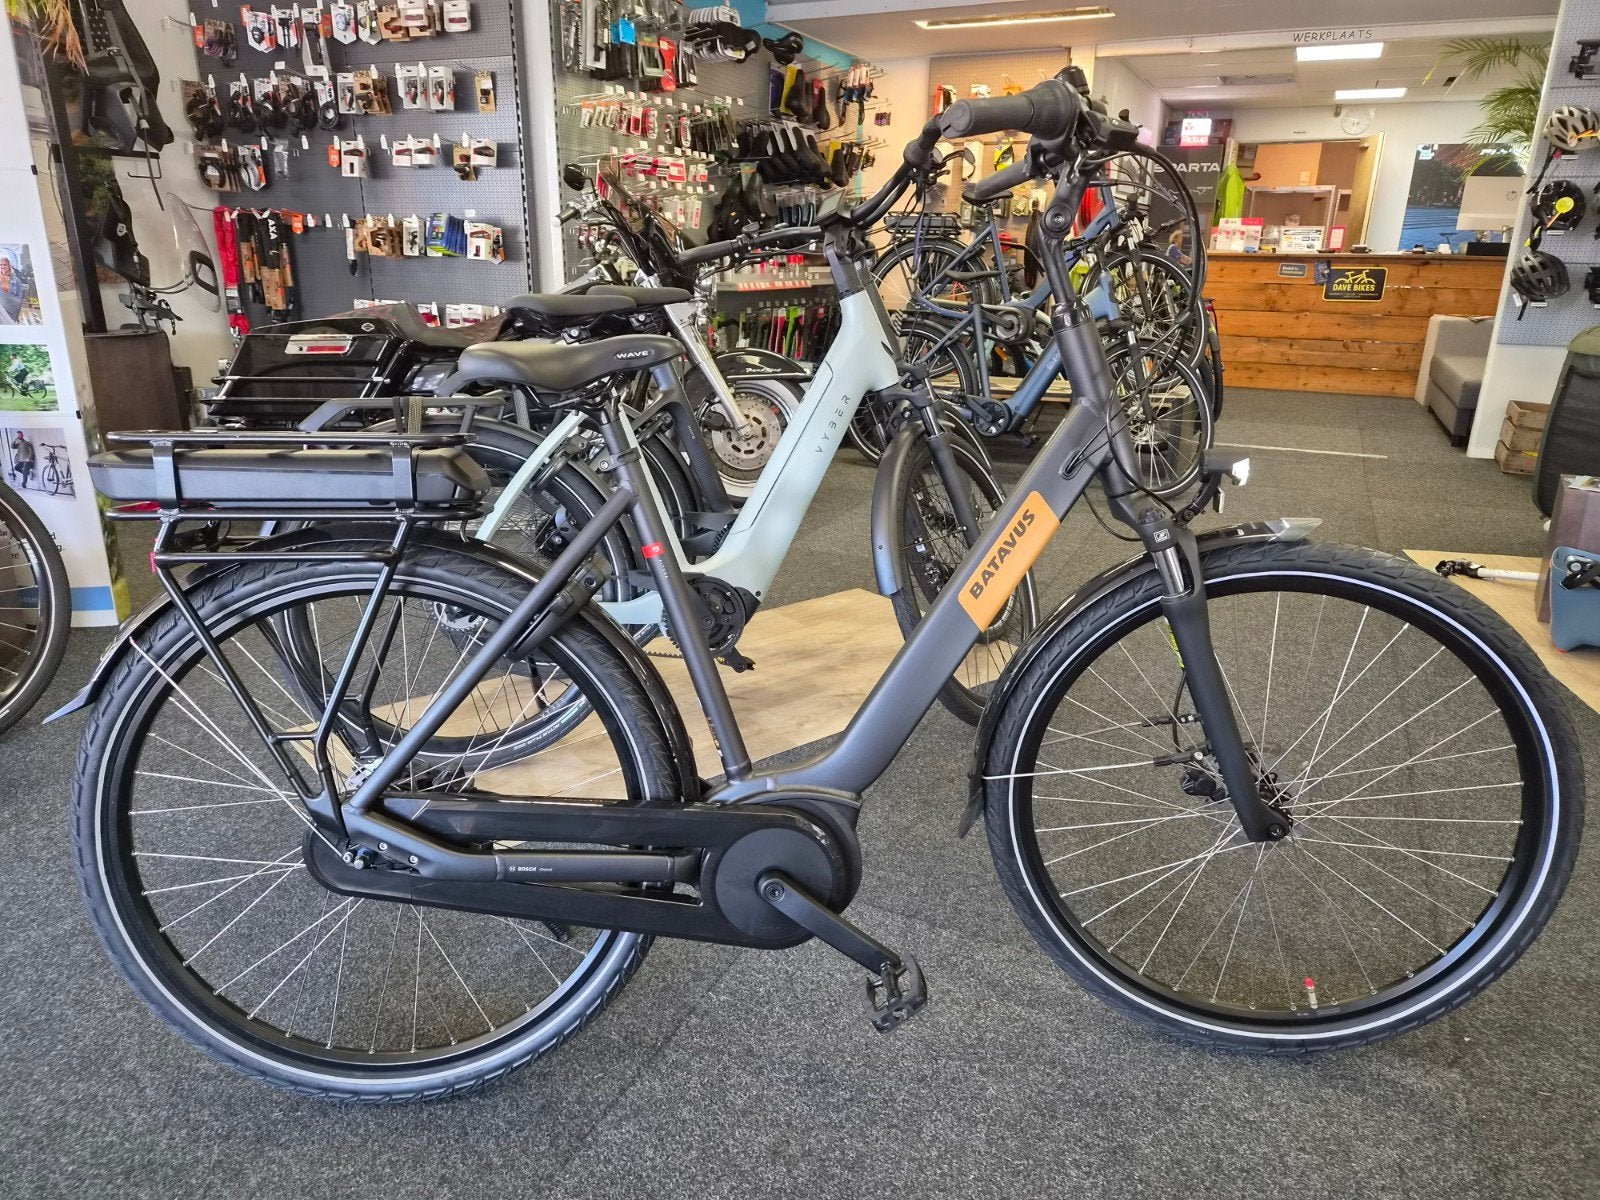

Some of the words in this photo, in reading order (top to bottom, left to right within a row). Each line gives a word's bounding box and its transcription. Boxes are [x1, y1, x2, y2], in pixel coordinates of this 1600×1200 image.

[1293, 29, 1373, 42] WERKPLAATS
[267, 218, 278, 240] AXA
[1332, 283, 1352, 291] DAVE
[1353, 283, 1376, 292] BIKES
[616, 350, 649, 359] WAVE
[969, 509, 1035, 600] BATAVUS
